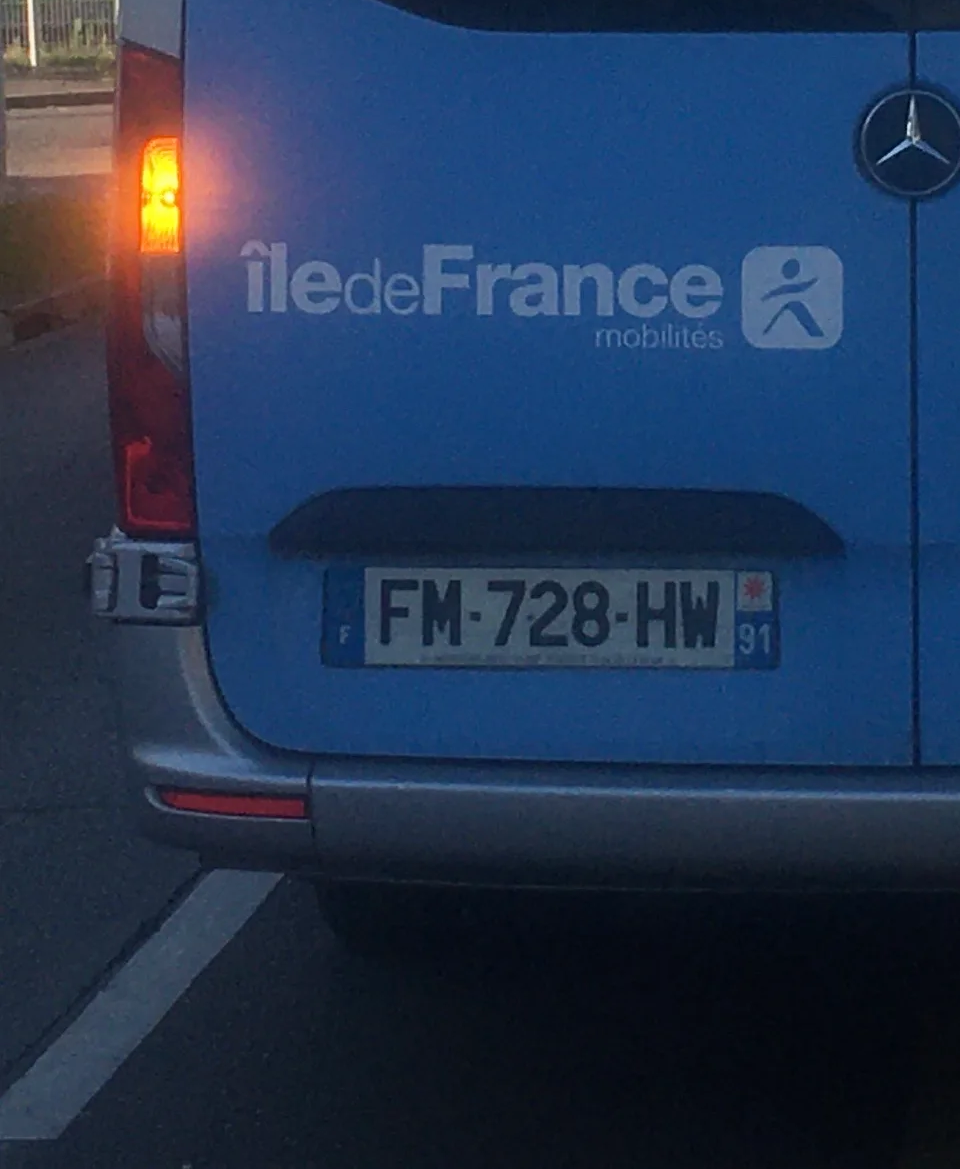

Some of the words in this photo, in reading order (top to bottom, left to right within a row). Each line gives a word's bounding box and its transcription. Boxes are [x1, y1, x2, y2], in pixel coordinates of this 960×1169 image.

[594, 322, 724, 350] mobilités
[379, 578, 721, 649] FM-728-HW
[338, 622, 352, 645] F
[738, 622, 771, 654] 91
